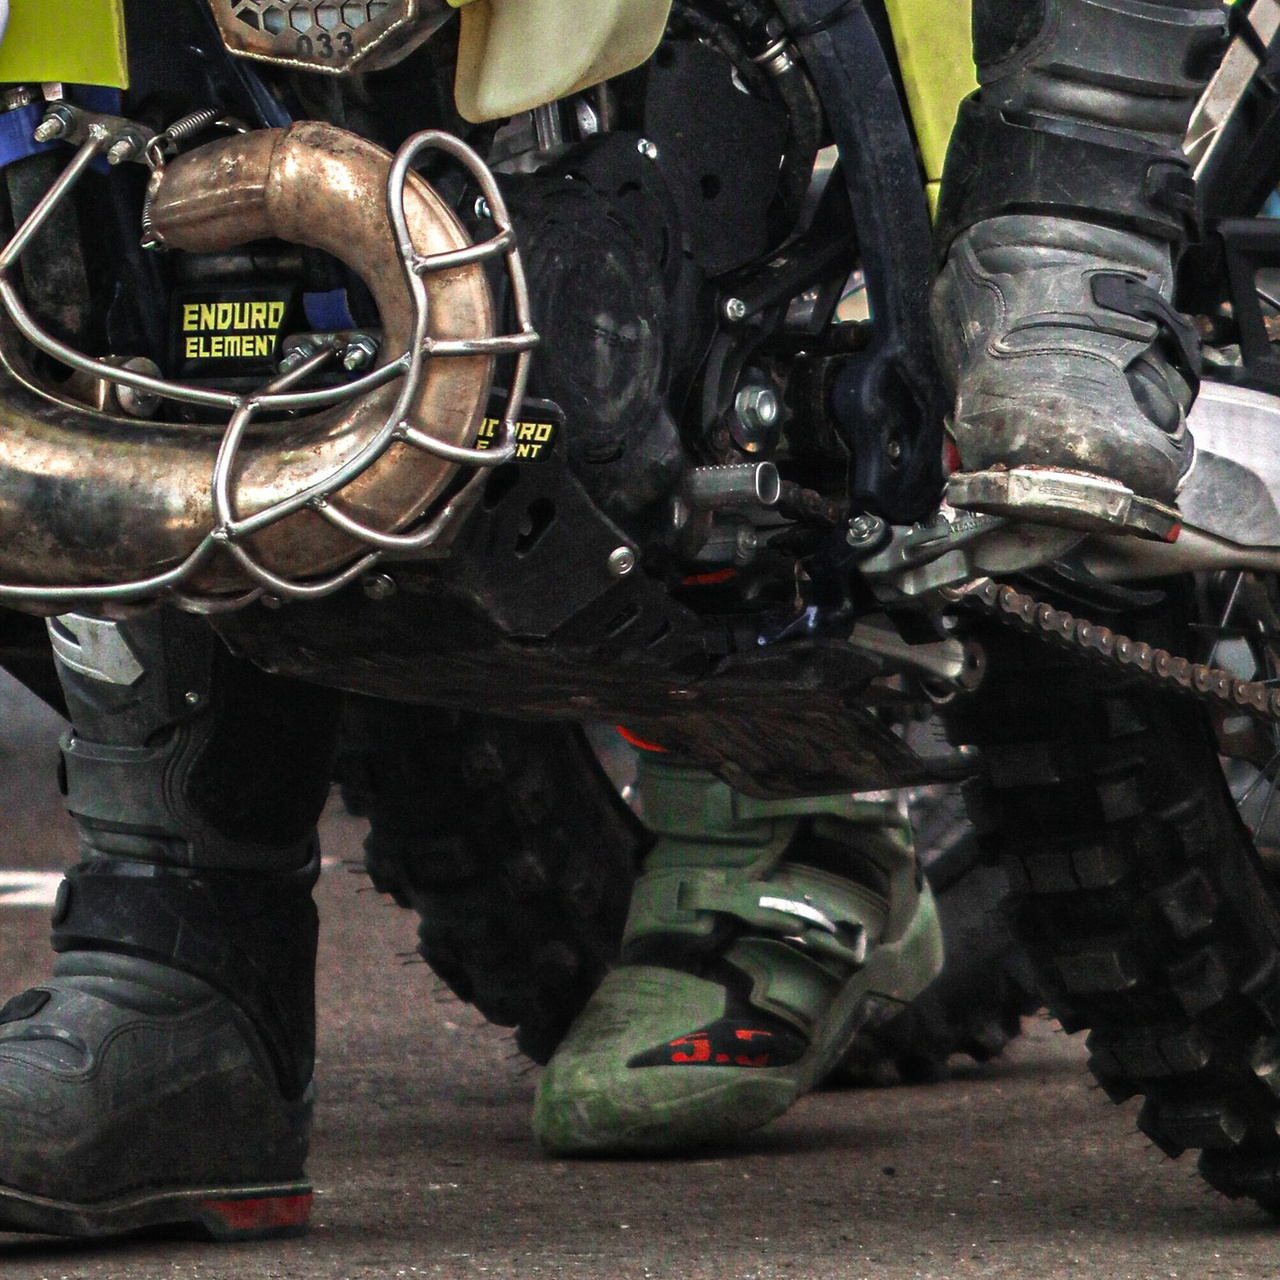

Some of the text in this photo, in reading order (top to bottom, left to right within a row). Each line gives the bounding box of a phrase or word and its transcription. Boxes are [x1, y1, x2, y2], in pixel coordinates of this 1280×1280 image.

[296, 32, 354, 58] 033
[183, 302, 284, 331] ENDURO
[186, 335, 276, 358] ELEMENT
